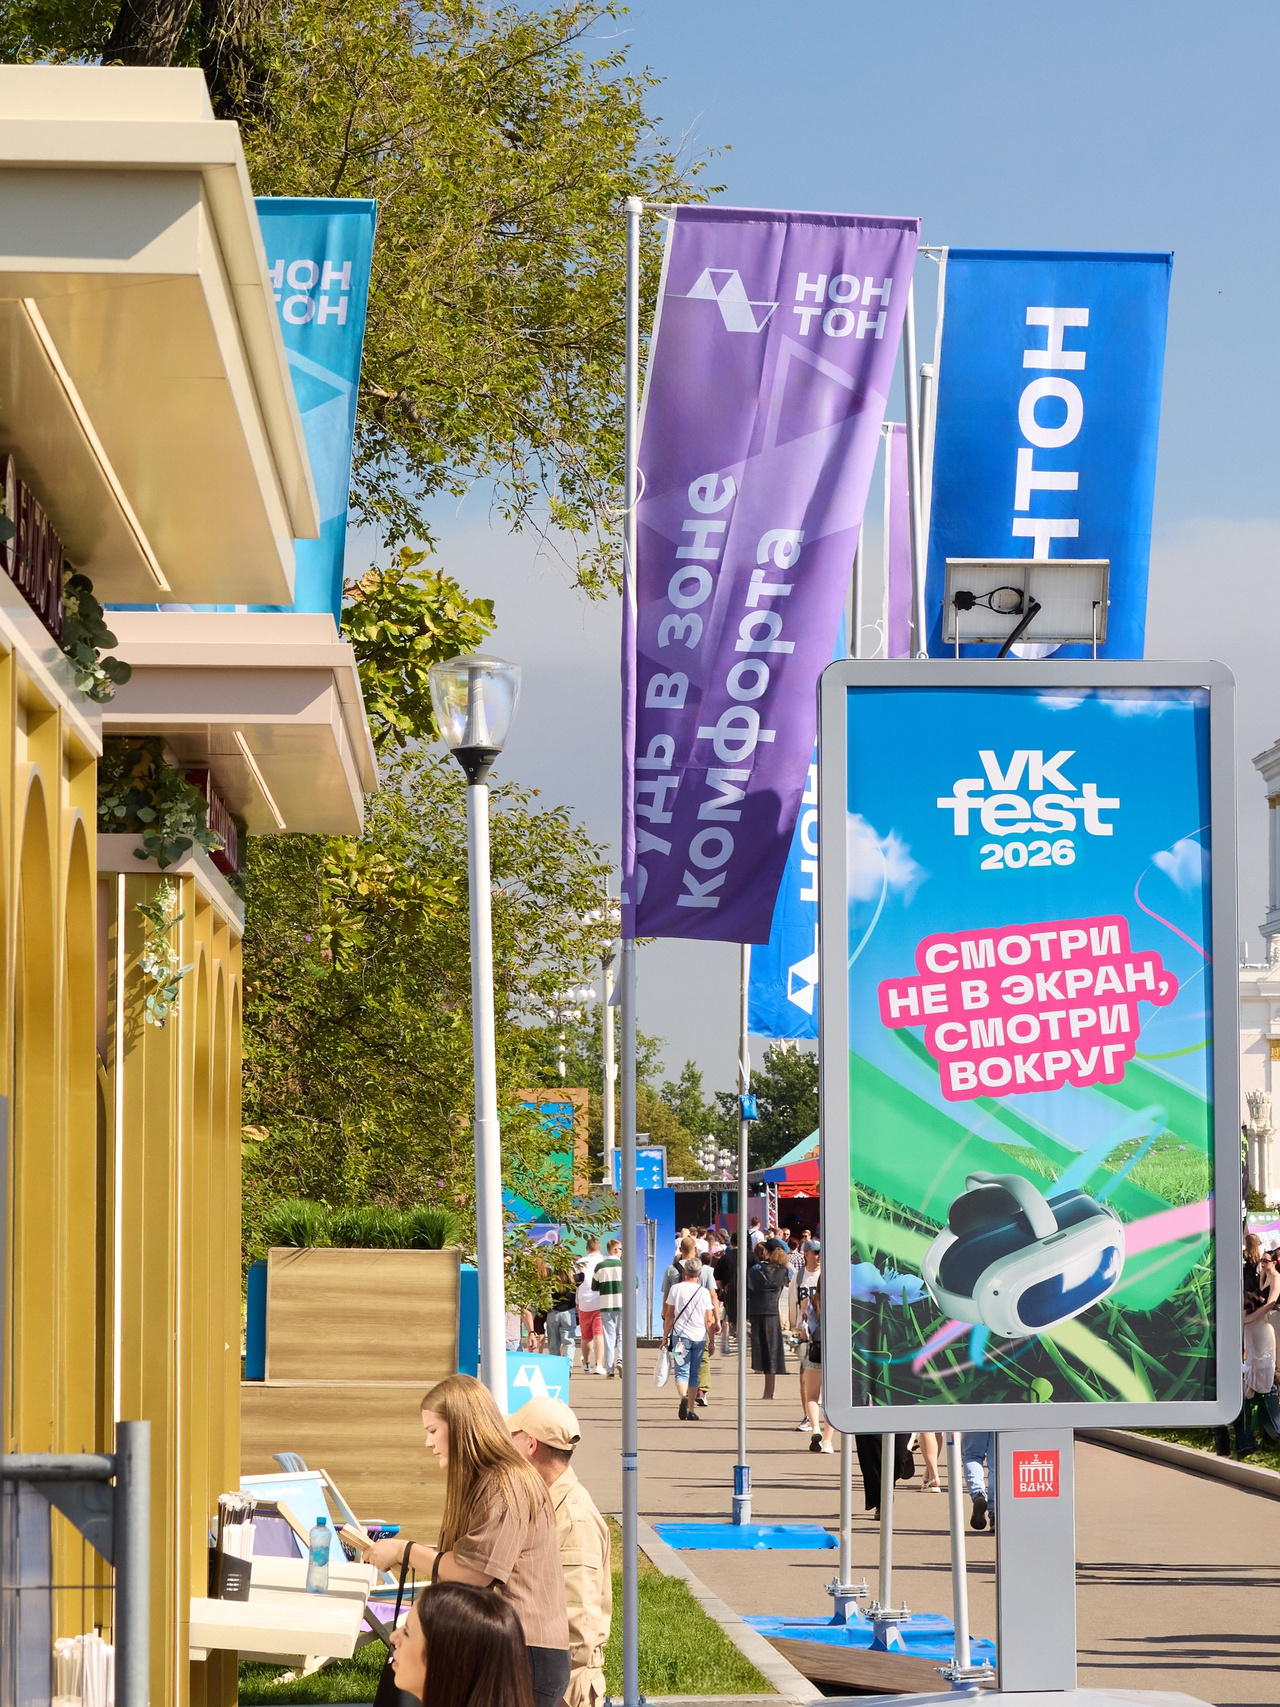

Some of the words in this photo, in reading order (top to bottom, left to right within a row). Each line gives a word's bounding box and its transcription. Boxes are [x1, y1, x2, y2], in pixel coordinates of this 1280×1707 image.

[272, 293, 349, 325] ОН
[795, 272, 893, 306] НОН
[793, 306, 888, 339] ТОН
[1010, 306, 1090, 659] НТОН
[658, 472, 737, 649] зоне
[676, 528, 805, 908] комфорта
[978, 750, 1078, 790] VK
[937, 778, 1120, 836] fest
[979, 839, 1076, 870] 2026
[925, 925, 1121, 973] СМОТРИ
[888, 984, 948, 1018] НЕ
[961, 979, 990, 1010] В
[1000, 961, 1169, 1005] ЭКРАН,
[934, 1004, 1131, 1052] СМОТРИ
[949, 1044, 1126, 1091] ВОКРУГ
[1020, 1482, 1054, 1492] ВДНХ
